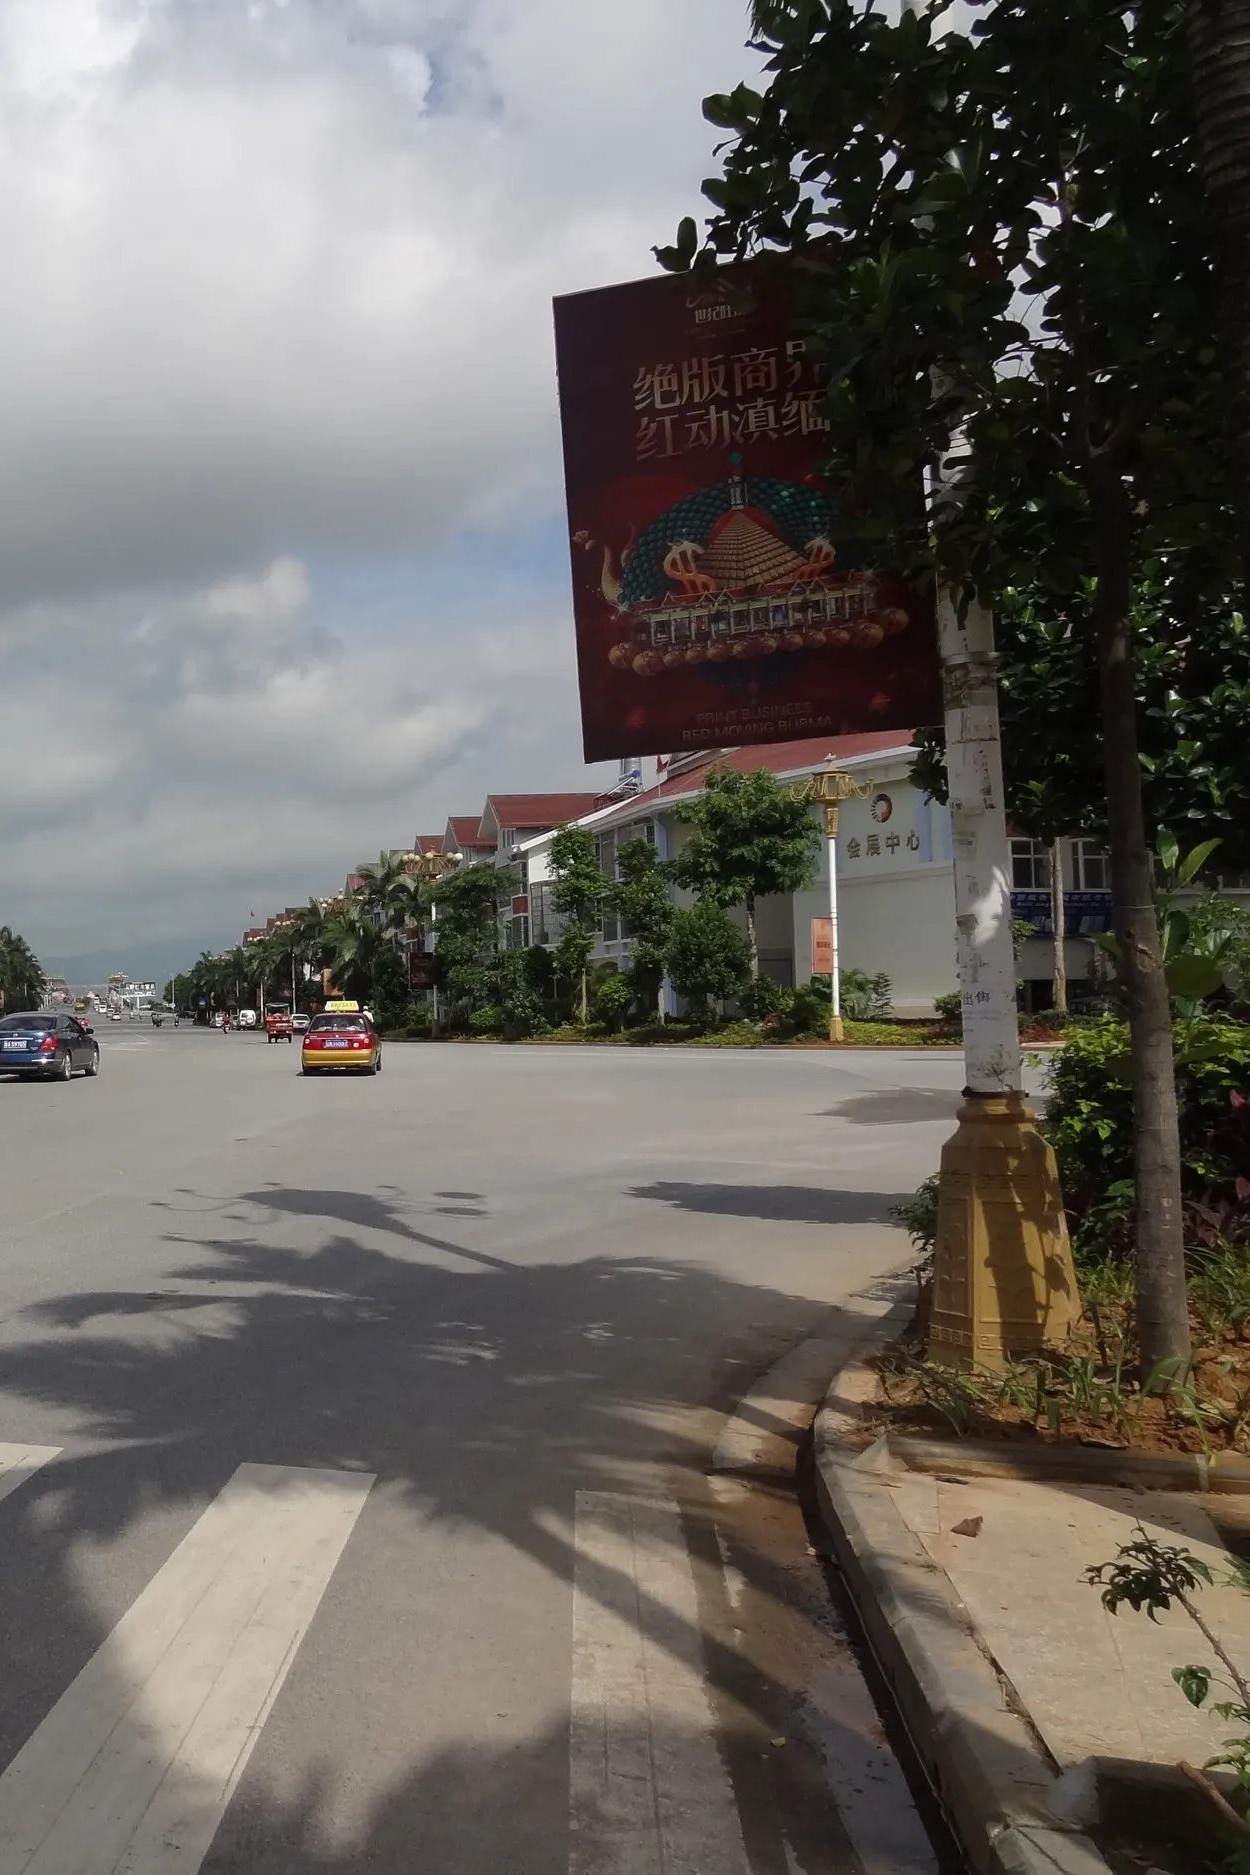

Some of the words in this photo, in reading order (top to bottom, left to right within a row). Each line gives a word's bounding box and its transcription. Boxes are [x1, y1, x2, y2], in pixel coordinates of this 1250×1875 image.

[635, 389, 831, 462] 红动滇缅
[697, 710, 738, 724] PRINT
[742, 702, 812, 720] BUSINESS
[682, 728, 711, 741] RED
[715, 721, 774, 738] MOVING
[778, 715, 832, 732] BURMA
[846, 830, 920, 859] 会展中心
